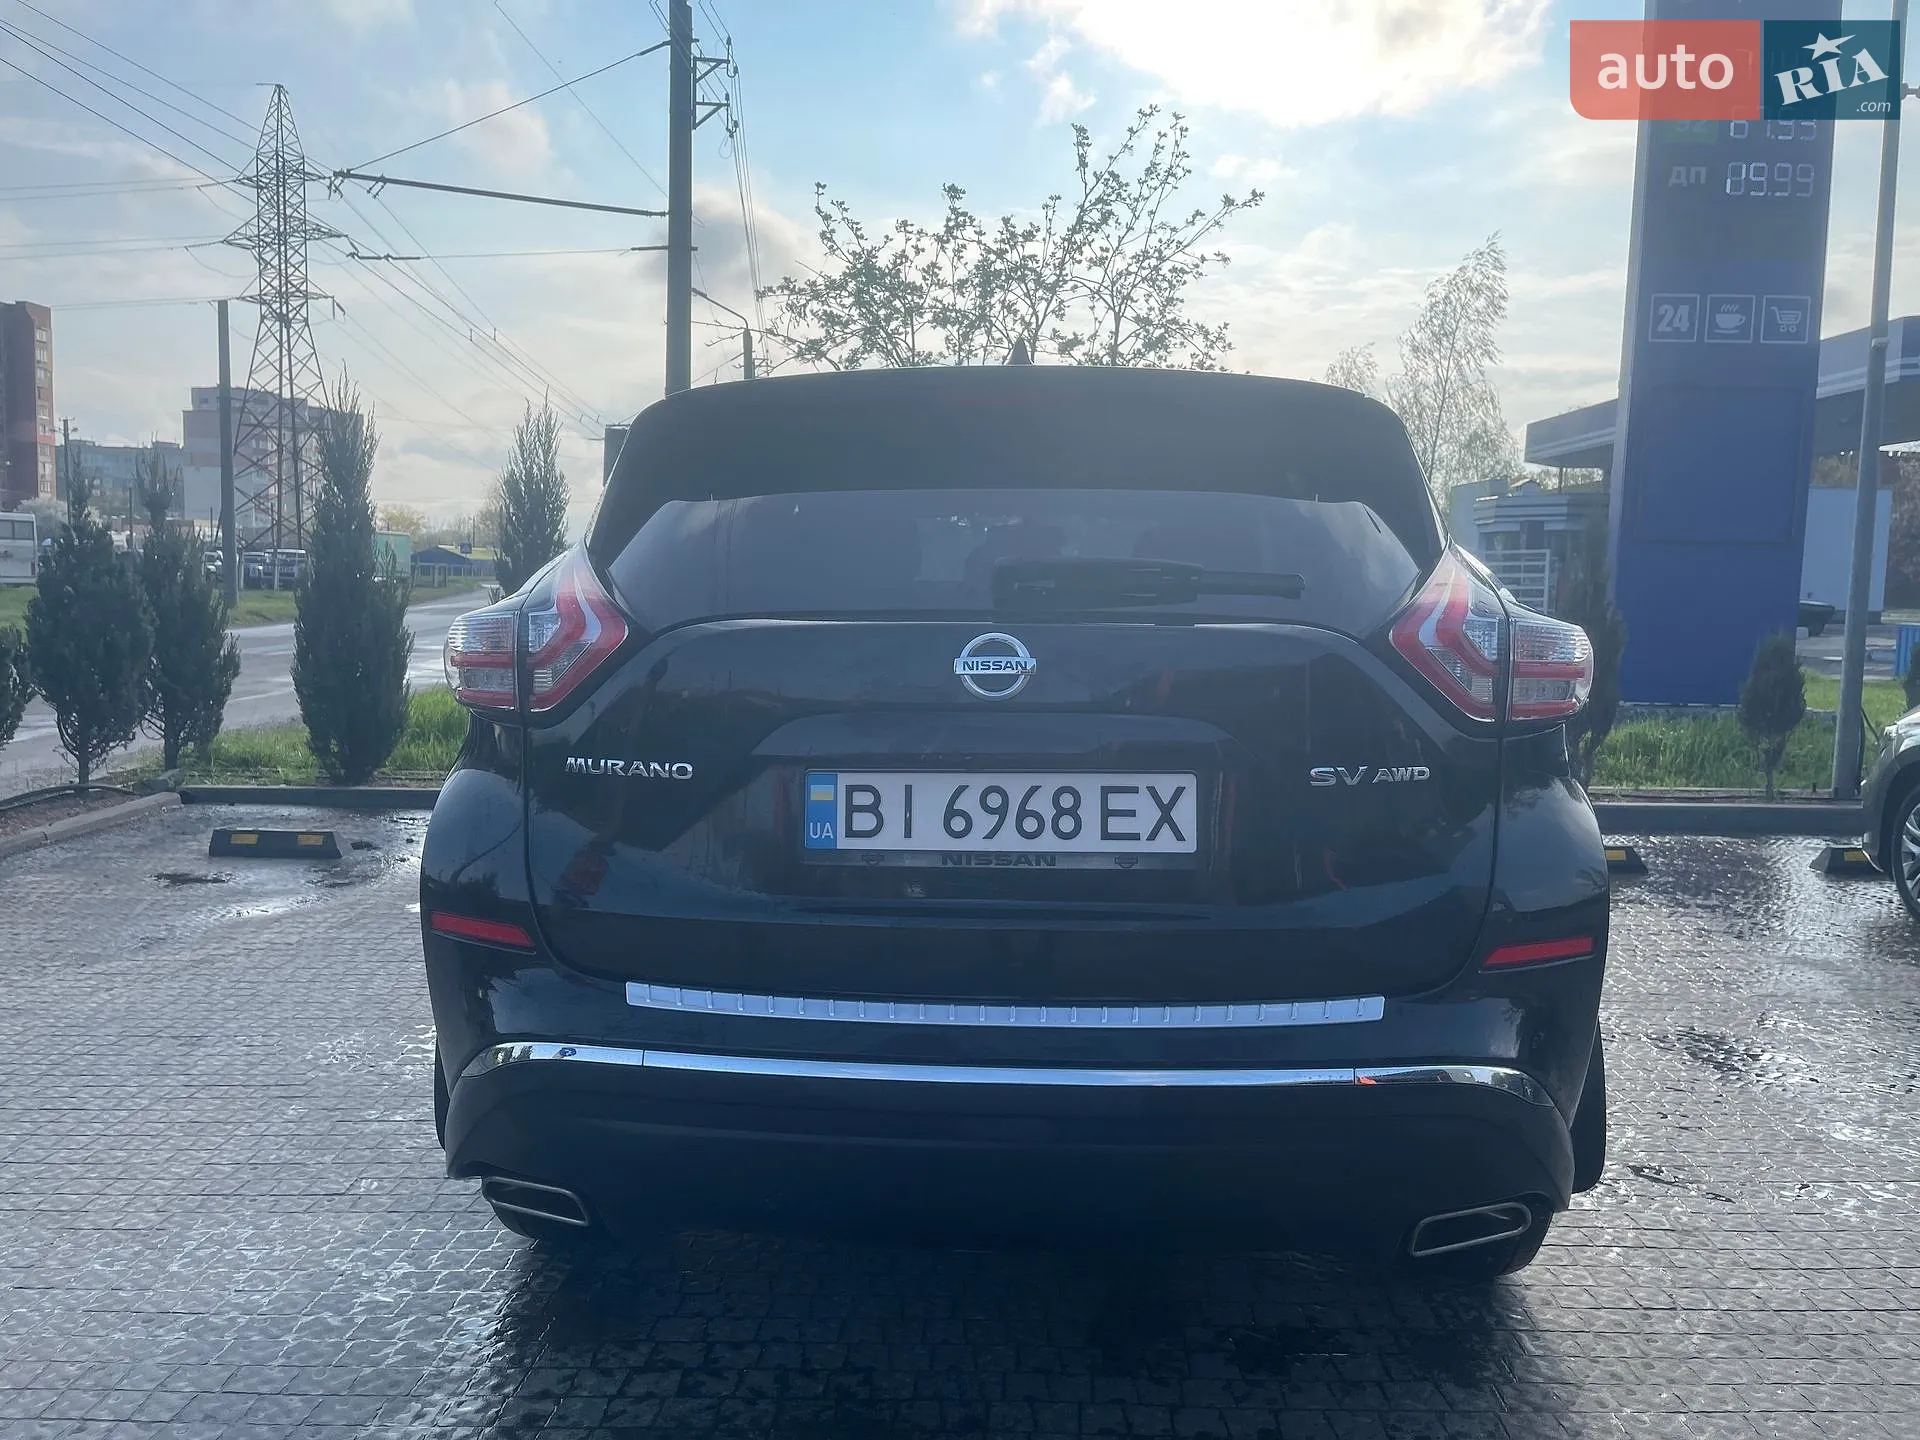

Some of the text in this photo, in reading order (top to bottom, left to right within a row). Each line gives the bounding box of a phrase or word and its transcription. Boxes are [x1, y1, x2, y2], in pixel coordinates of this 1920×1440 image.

[1668, 165, 1708, 188] ДП
[1657, 305, 1690, 333] 24
[962, 660, 1028, 671] NISSAN
[565, 756, 694, 780] MURANO
[1309, 766, 1431, 787] SV AWD
[844, 783, 1187, 842] BI 6968 EX
[809, 822, 835, 840] UA
[940, 854, 1058, 868] NISSAN
